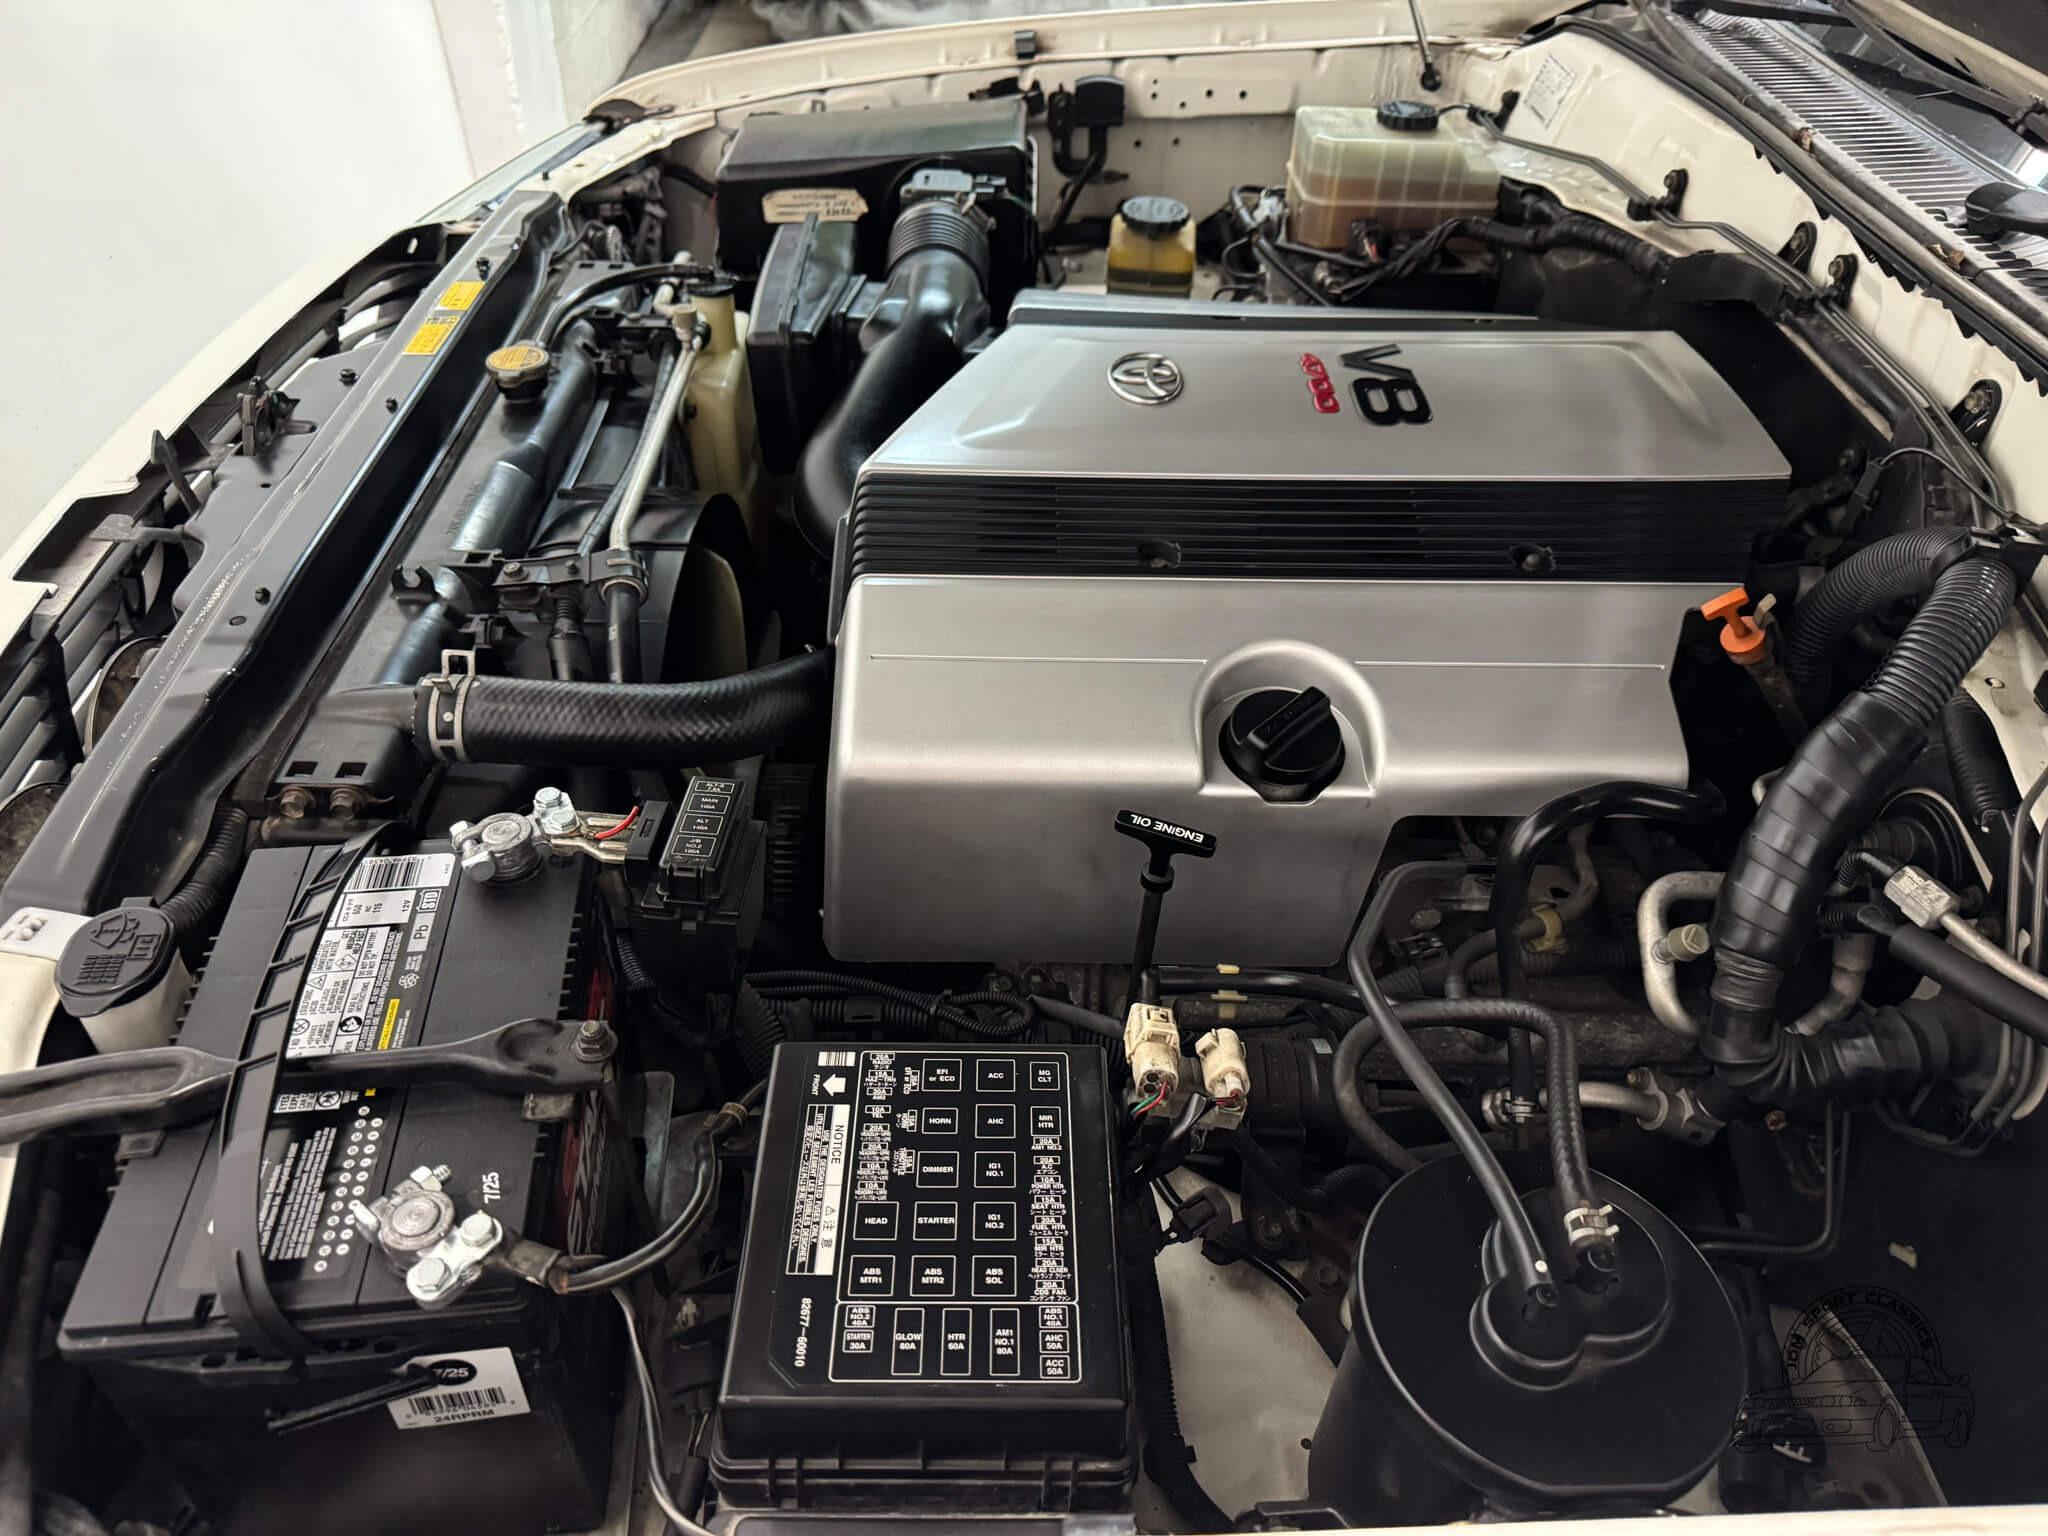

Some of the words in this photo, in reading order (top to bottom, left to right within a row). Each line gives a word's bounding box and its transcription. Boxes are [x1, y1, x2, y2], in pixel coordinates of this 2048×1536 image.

[1339, 343, 1433, 426] V8
[1130, 814, 1152, 827] OIL
[1153, 821, 1204, 843] ENGINE
[400, 898, 411, 912] 12V
[413, 924, 429, 940] Pb
[811, 1074, 820, 1096] FRONT
[822, 1129, 830, 1142] USE
[821, 1143, 829, 1156] THE
[831, 1125, 845, 1164] NOTICE
[816, 1158, 827, 1198] DESIGNATED
[482, 1171, 501, 1204] 7/25
[813, 1200, 822, 1222] FUSES
[860, 1276, 882, 1284] MTR1
[921, 1276, 945, 1284] MTR2
[985, 1276, 1003, 1284] SOL
[794, 1297, 812, 1367] 82677-60010
[895, 1333, 922, 1341] GLOW
[995, 1338, 1014, 1346] NO.1
[432, 1367, 469, 1378] 7/25
